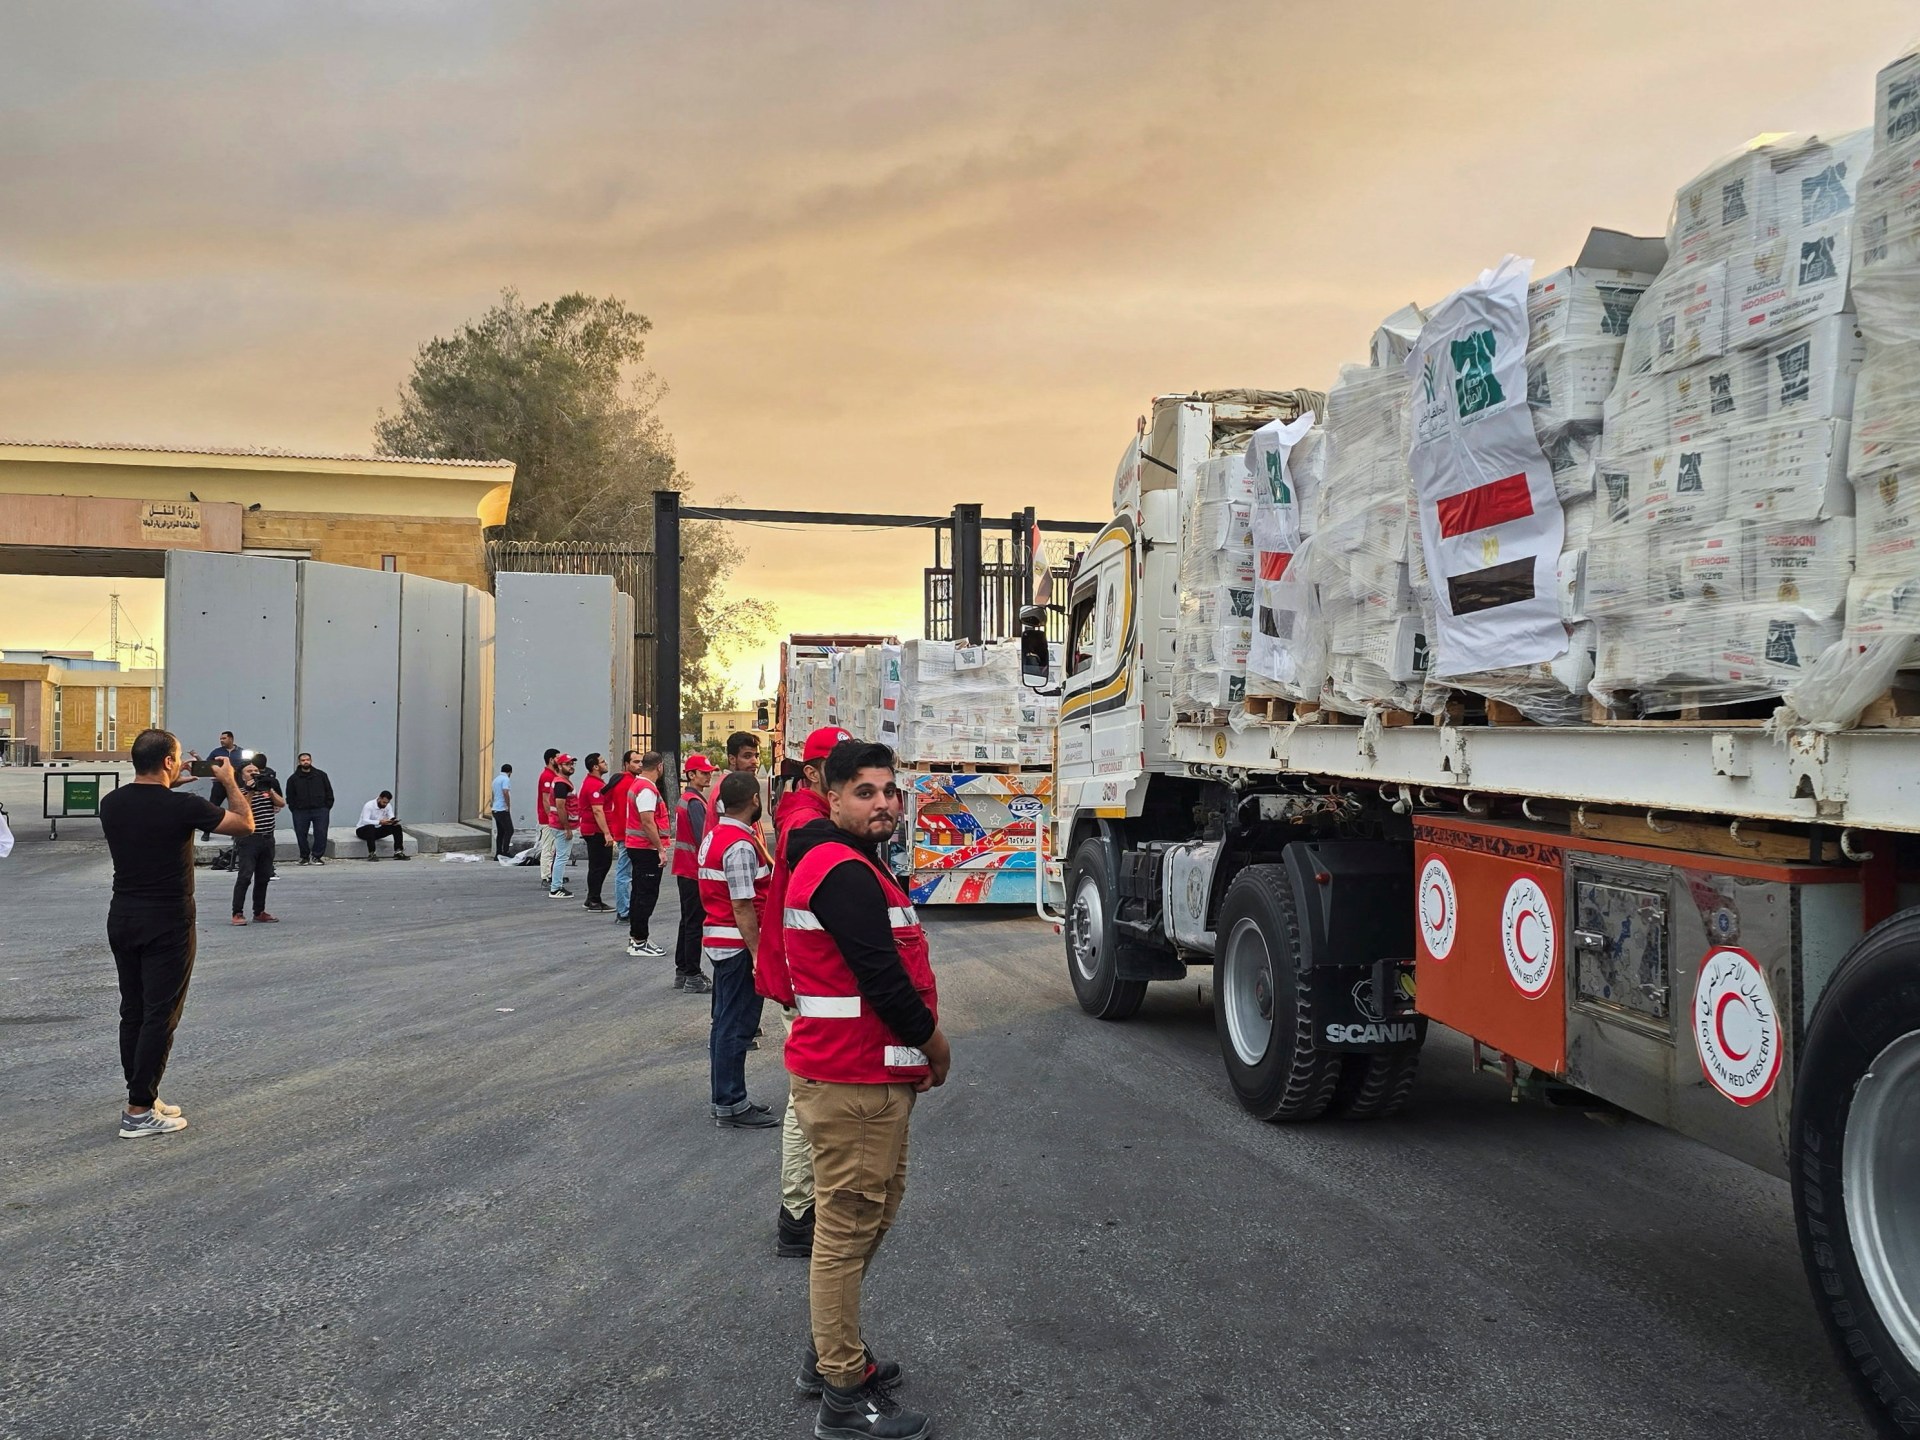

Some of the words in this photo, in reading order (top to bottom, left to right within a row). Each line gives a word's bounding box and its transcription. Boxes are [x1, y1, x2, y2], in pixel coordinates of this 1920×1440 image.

[149, 504, 176, 517] النقل
[1771, 557, 1808, 567] BAZNAS
[1505, 932, 1522, 978] EGYPTIAN
[1523, 973, 1533, 984] RED
[1533, 937, 1551, 982] CRESCENT
[1325, 1023, 1417, 1044] SCANIA
[1701, 1020, 1727, 1080] EGYPTIAN
[1728, 1072, 1745, 1087] RED
[1745, 1027, 1770, 1085] CRESCENT
